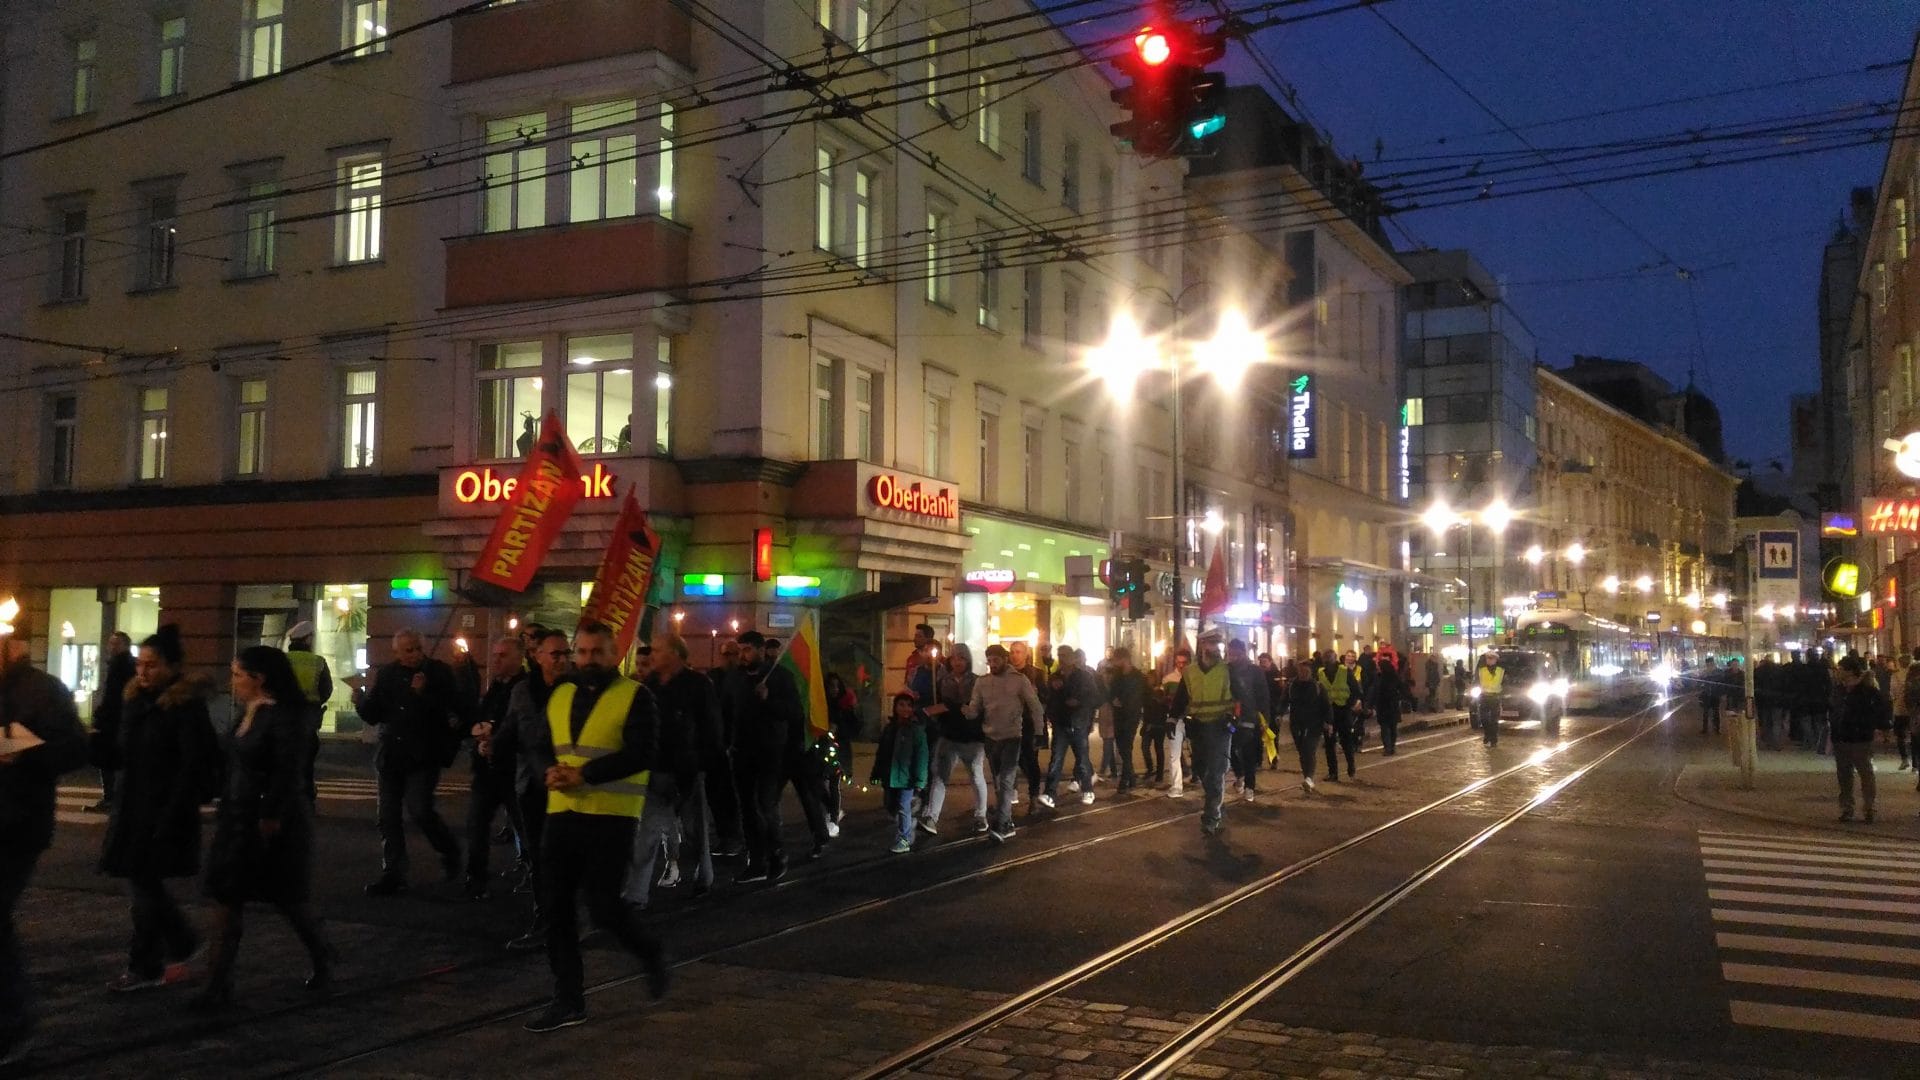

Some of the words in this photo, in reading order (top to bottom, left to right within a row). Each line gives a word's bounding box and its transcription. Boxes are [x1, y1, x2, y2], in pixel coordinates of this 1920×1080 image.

[1293, 392, 1310, 450] Thalia
[455, 464, 612, 502] Obenk
[877, 475, 956, 519] Oberbank
[601, 548, 653, 640] ARTIZAN
